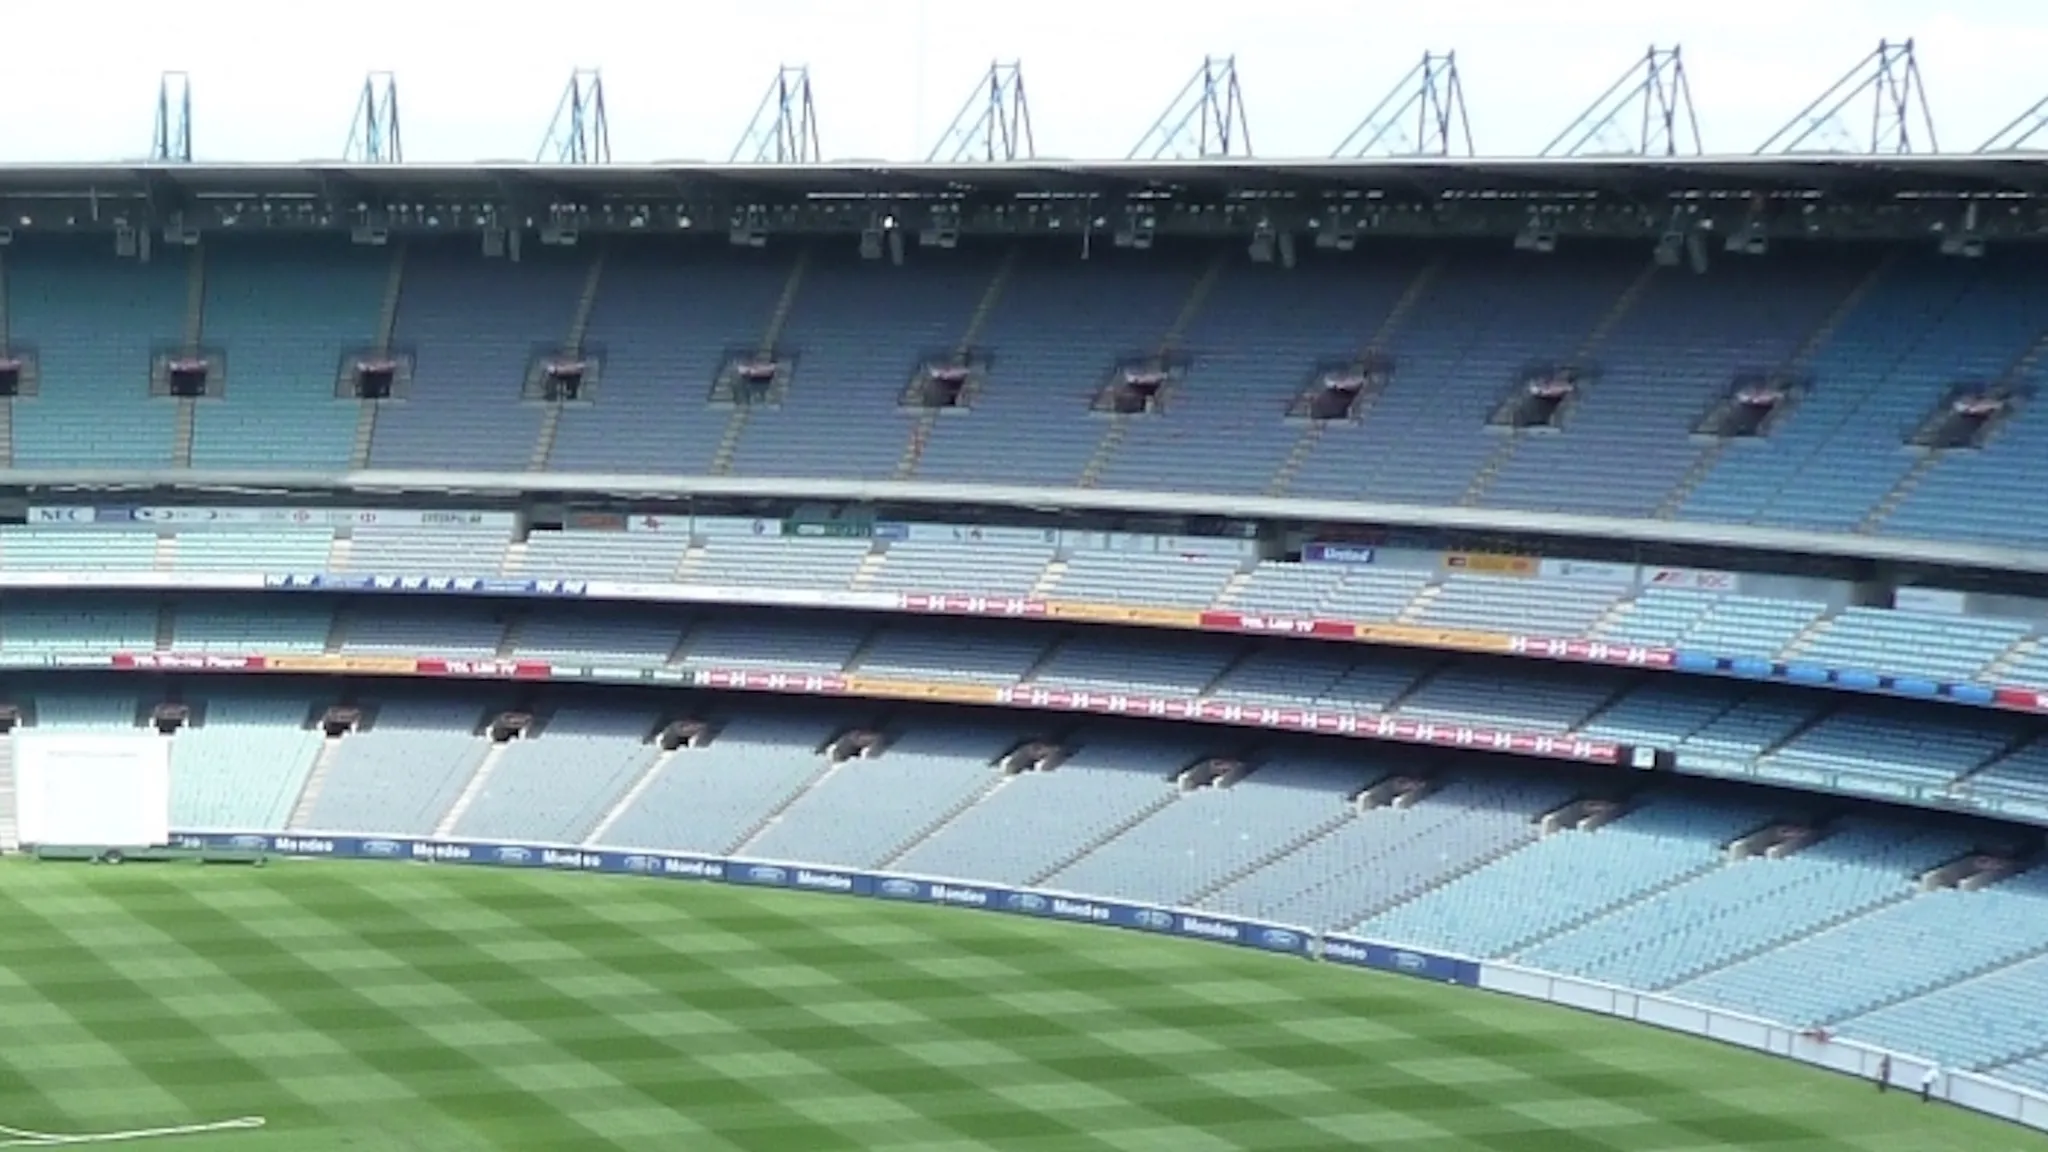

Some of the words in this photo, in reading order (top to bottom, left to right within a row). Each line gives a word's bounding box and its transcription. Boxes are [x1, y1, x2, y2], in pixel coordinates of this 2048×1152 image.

[41, 509, 76, 521] NEC
[274, 837, 333, 853] Mondeo
[412, 842, 471, 859] Mondeo
[543, 849, 600, 866] Mondeo
[665, 859, 723, 876] Mondeo
[796, 870, 852, 889] Mondeo
[930, 884, 987, 904] Mondeo
[1053, 899, 1110, 920] Mondeo
[1183, 917, 1239, 939] Mondeo
